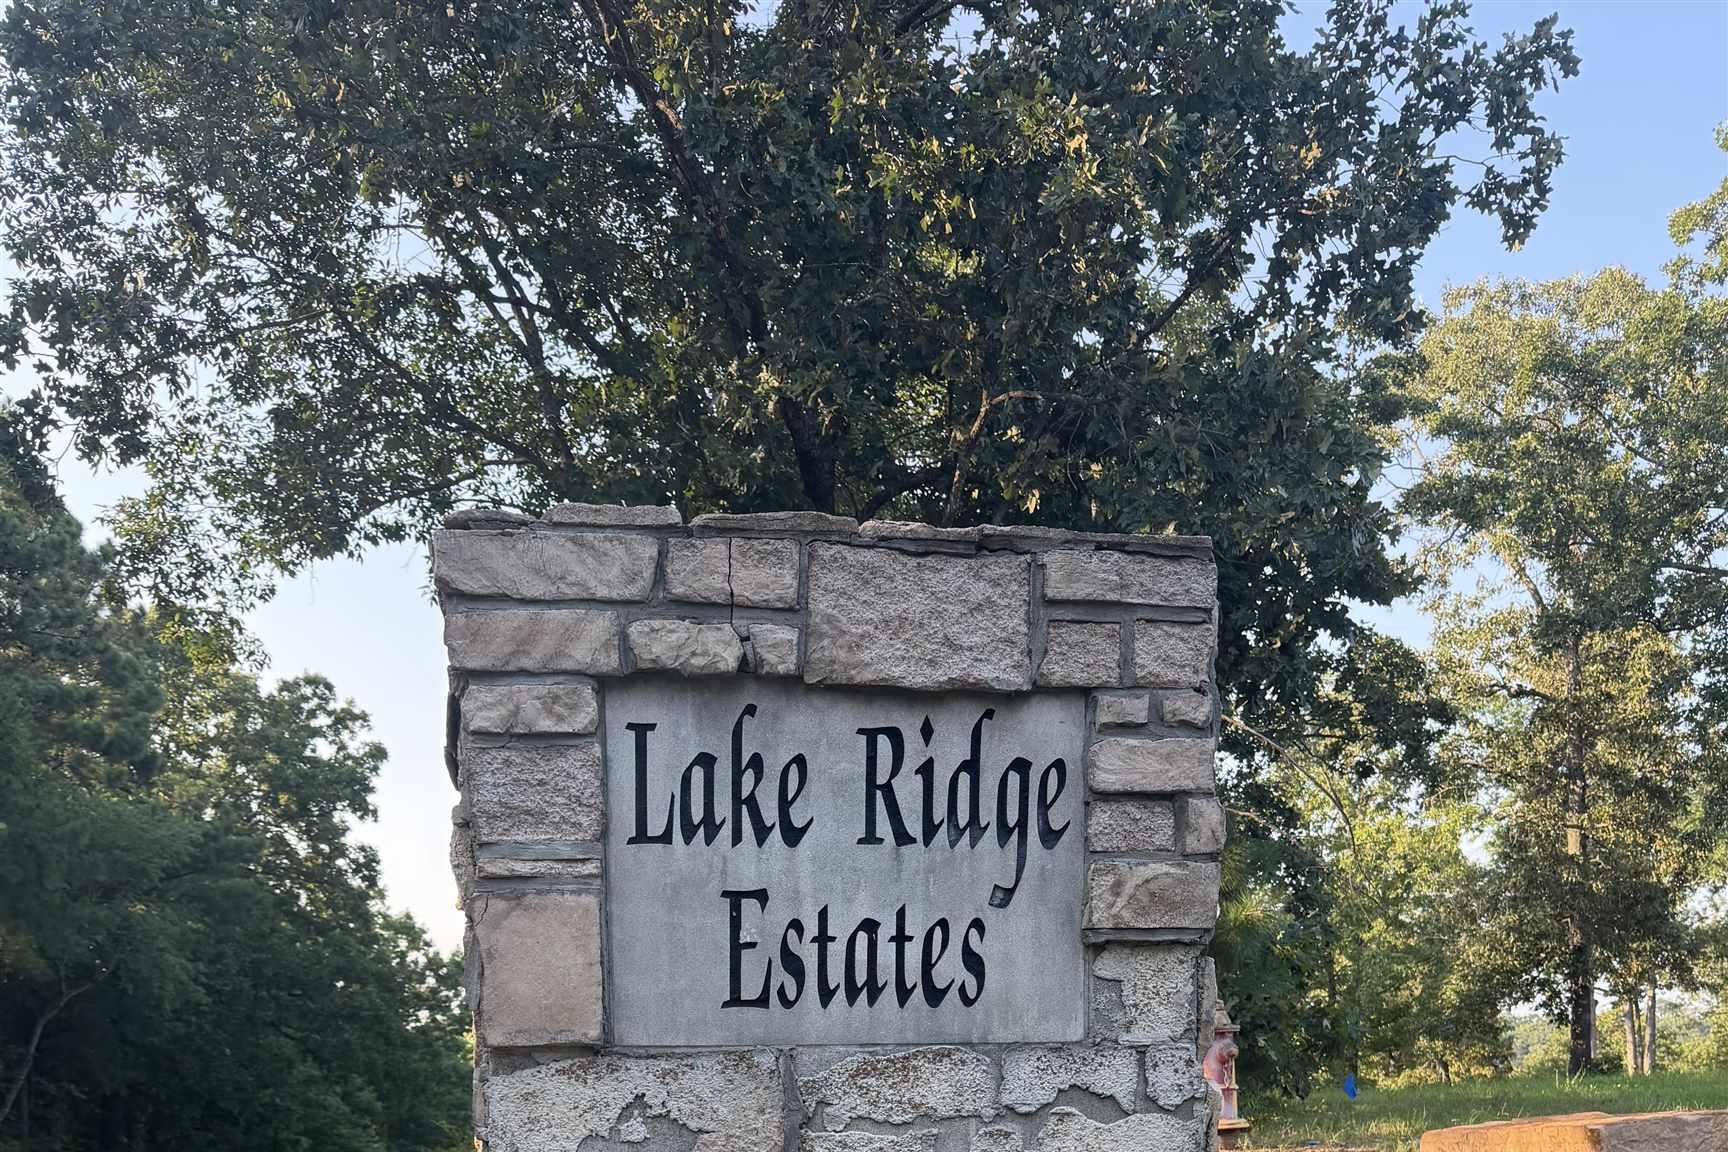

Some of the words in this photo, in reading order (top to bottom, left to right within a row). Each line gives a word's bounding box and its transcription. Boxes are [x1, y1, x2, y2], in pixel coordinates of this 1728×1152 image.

[625, 703, 815, 849] Lake
[855, 708, 1072, 909] Ridge
[719, 887, 986, 1010] Estates
